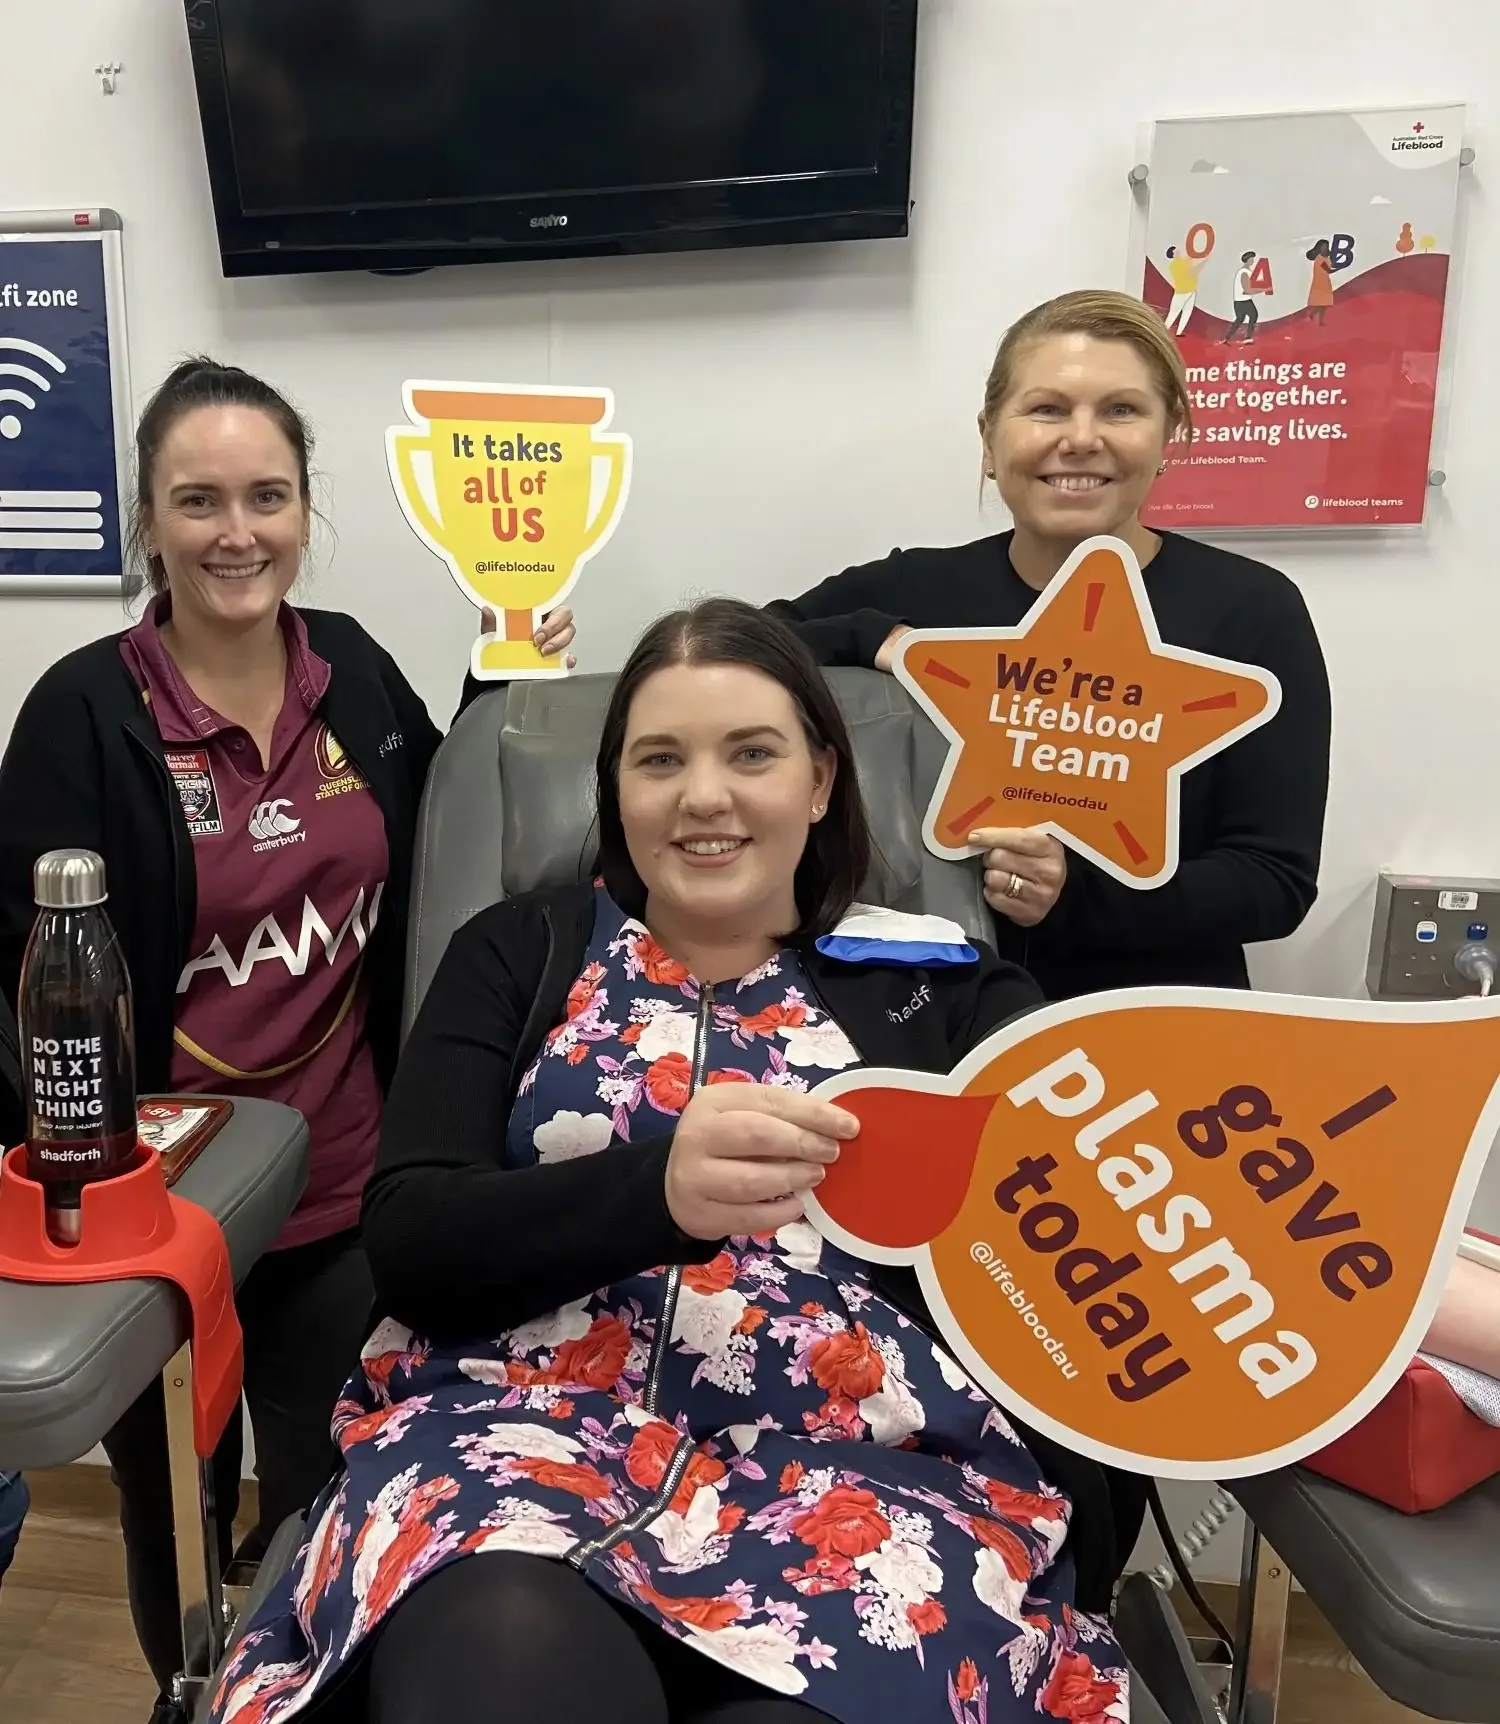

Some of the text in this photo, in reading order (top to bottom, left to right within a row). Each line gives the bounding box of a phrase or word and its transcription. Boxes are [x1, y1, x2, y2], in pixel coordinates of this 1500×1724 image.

[1391, 140, 1443, 151] Lifeblood
[530, 214, 568, 228] SANYO
[0, 283, 78, 307] fi zone
[1185, 358, 1346, 385] me things are
[1186, 385, 1347, 412] ter together.
[1168, 418, 1348, 446] ke saving lives.
[452, 433, 563, 463] It takes
[1190, 456, 1236, 465] Lifeblood
[1238, 455, 1268, 463] Team.
[463, 467, 547, 504] all of
[1322, 498, 1404, 507] lifeblood teams
[475, 561, 555, 574] @lifebloodau
[1122, 683, 1143, 706] a
[988, 694, 1164, 743] Lifeblood
[1005, 729, 1130, 782] Team
[315, 788, 341, 801] STATE
[341, 784, 353, 793] OF
[319, 775, 363, 792] QUEENSL
[1002, 786, 1108, 811] @lifebloodau
[252, 831, 306, 853] canterbury
[32, 1036, 101, 1055] DO THE
[33, 1057, 101, 1076] NEXT
[34, 1078, 102, 1097] RIGHT
[35, 1098, 103, 1117] THING
[1320, 1084, 1398, 1140] I
[40, 1148, 101, 1162] shadforth
[1177, 1084, 1394, 1302] gave
[1005, 1047, 1317, 1400] plasma
[993, 1152, 1192, 1403] today
[969, 1241, 1080, 1380] @lifebloodau
